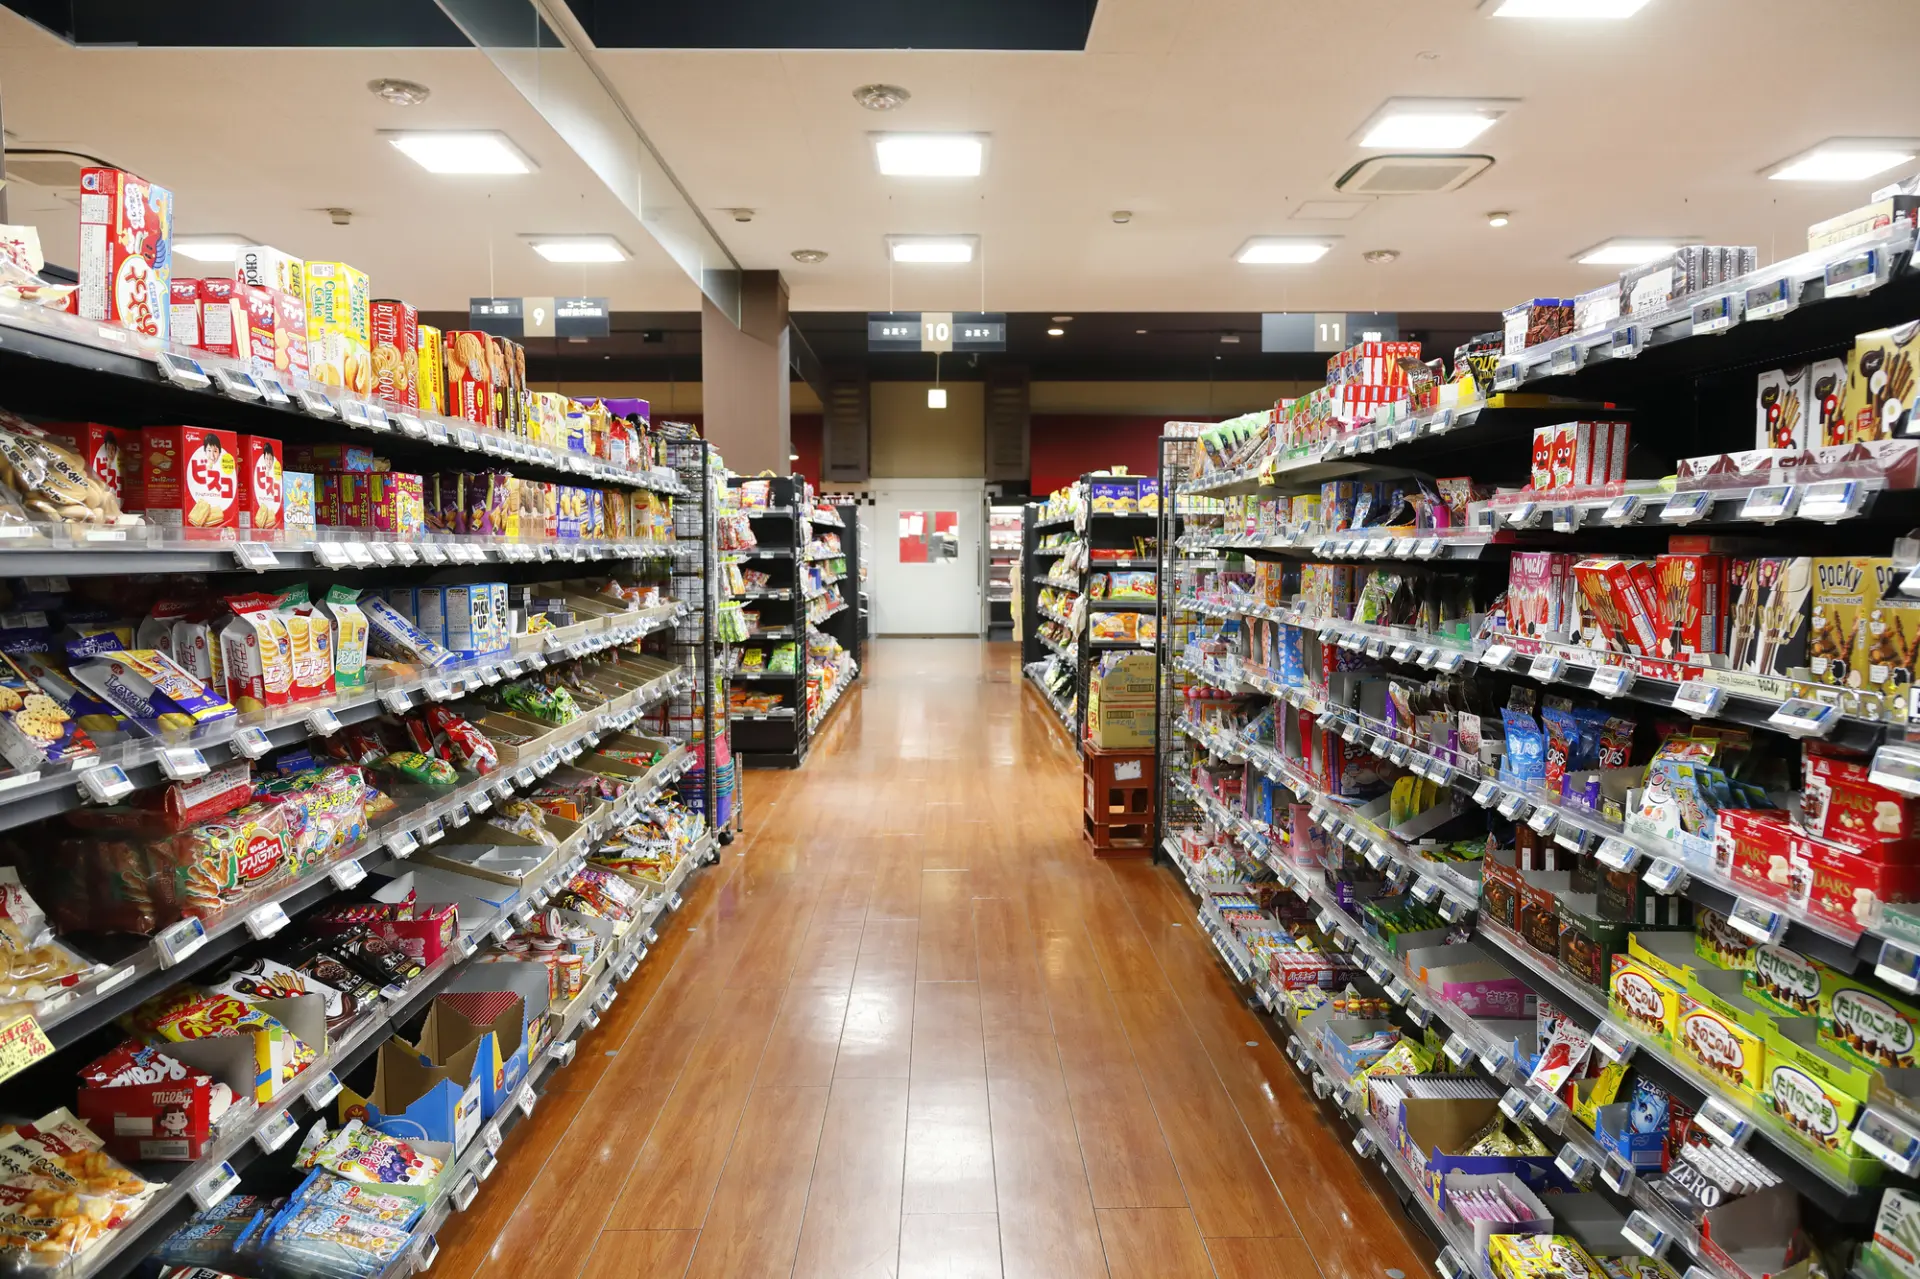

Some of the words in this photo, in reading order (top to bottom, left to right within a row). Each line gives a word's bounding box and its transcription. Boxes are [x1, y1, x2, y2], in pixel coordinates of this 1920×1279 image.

[125, 265, 158, 337] おっとっと
[313, 287, 325, 317] Cake
[325, 280, 337, 325] Custard
[351, 283, 360, 328] Cake
[358, 276, 367, 342] Custard
[377, 304, 394, 347] BUTTER
[404, 304, 417, 352] BUTTER
[533, 307, 545, 327] 9
[883, 327, 908, 336] お菓子
[926, 323, 949, 341] 10
[965, 329, 990, 337] お菓子
[1320, 323, 1340, 342] 11
[151, 438, 172, 448] ビスコ
[191, 459, 233, 499] ビスコ
[256, 465, 281, 503] ビスコ
[1096, 488, 1113, 496] Levain
[1117, 489, 1135, 497] Levain
[1142, 484, 1159, 493] Leva
[285, 511, 314, 524] Collon
[473, 601, 490, 615] PICK
[495, 597, 501, 622] UP
[499, 589, 507, 629] PICK
[477, 615, 488, 630] UP
[295, 657, 328, 679] エントリー
[104, 672, 156, 719] Levain
[1831, 785, 1872, 812] DARS
[240, 843, 282, 875] アスパラガス
[1735, 837, 1767, 865] DARS
[253, 861, 270, 875] ビスケット
[1814, 872, 1851, 898] DARS
[1758, 949, 1818, 993] たけのこの里
[1486, 991, 1519, 1006] さける
[1503, 1003, 1518, 1013] グミ
[1622, 976, 1659, 1013] きのこの山
[1836, 995, 1907, 1048] たけのこの里
[1692, 1019, 1736, 1062] きのこの山
[1775, 1074, 1832, 1128] たけのこの里
[357, 1138, 390, 1173] 果汁グミ
[1670, 1158, 1720, 1208] ZERO
